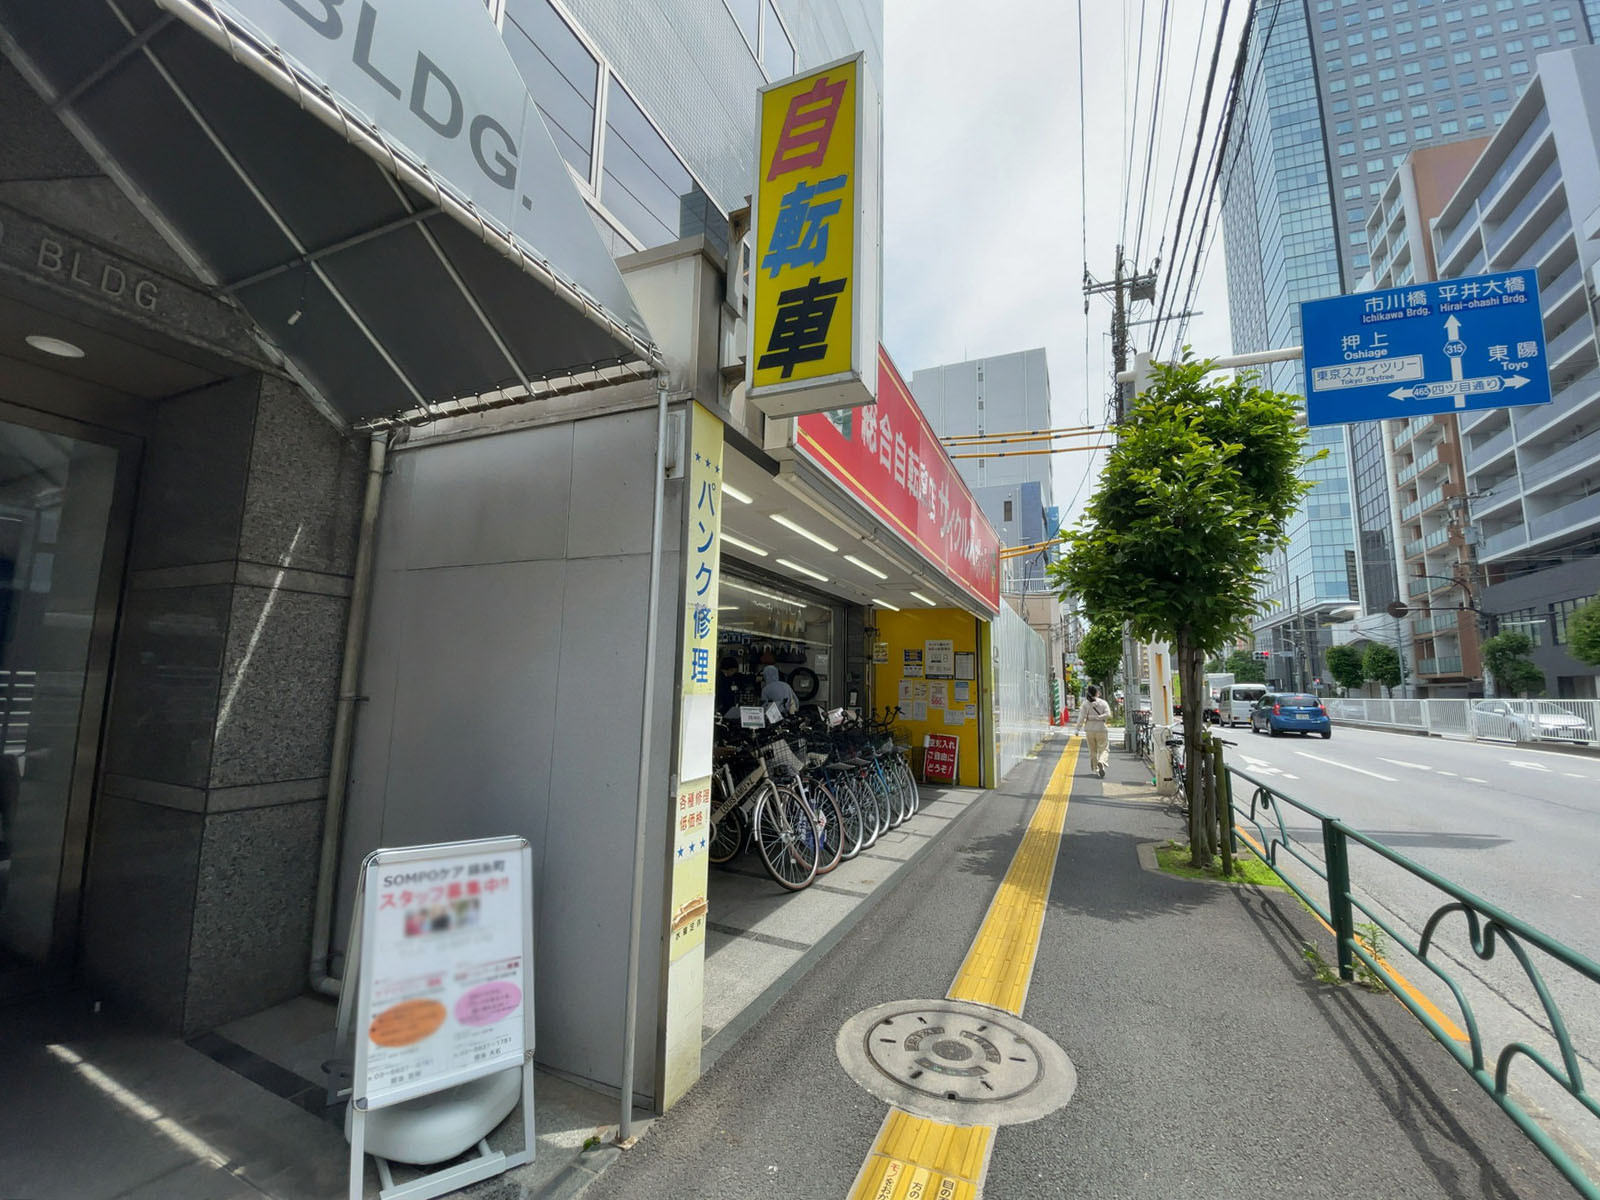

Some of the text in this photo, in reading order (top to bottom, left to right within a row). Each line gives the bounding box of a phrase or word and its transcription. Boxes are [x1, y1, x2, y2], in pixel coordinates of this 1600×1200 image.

[757, 76, 848, 379] 自転車
[1438, 276, 1526, 301] 平井大橋
[1364, 290, 1427, 313] 市川橋
[1440, 294, 1528, 312] Hirai-ohashi Brdg.
[1362, 307, 1431, 323] Ichikawa Brdg.
[1341, 332, 1389, 351] 押上
[1446, 343, 1463, 354] 315
[1488, 341, 1538, 361] 東陽
[1344, 348, 1388, 360] Oshiage
[1317, 360, 1417, 381] 東京スカイツリー
[1501, 361, 1528, 371] Toyo
[1366, 374, 1395, 383] Skytree
[1431, 379, 1498, 395] 四ツ目通り
[691, 480, 716, 683] パンク修理
[383, 864, 464, 888] SOMPOケア
